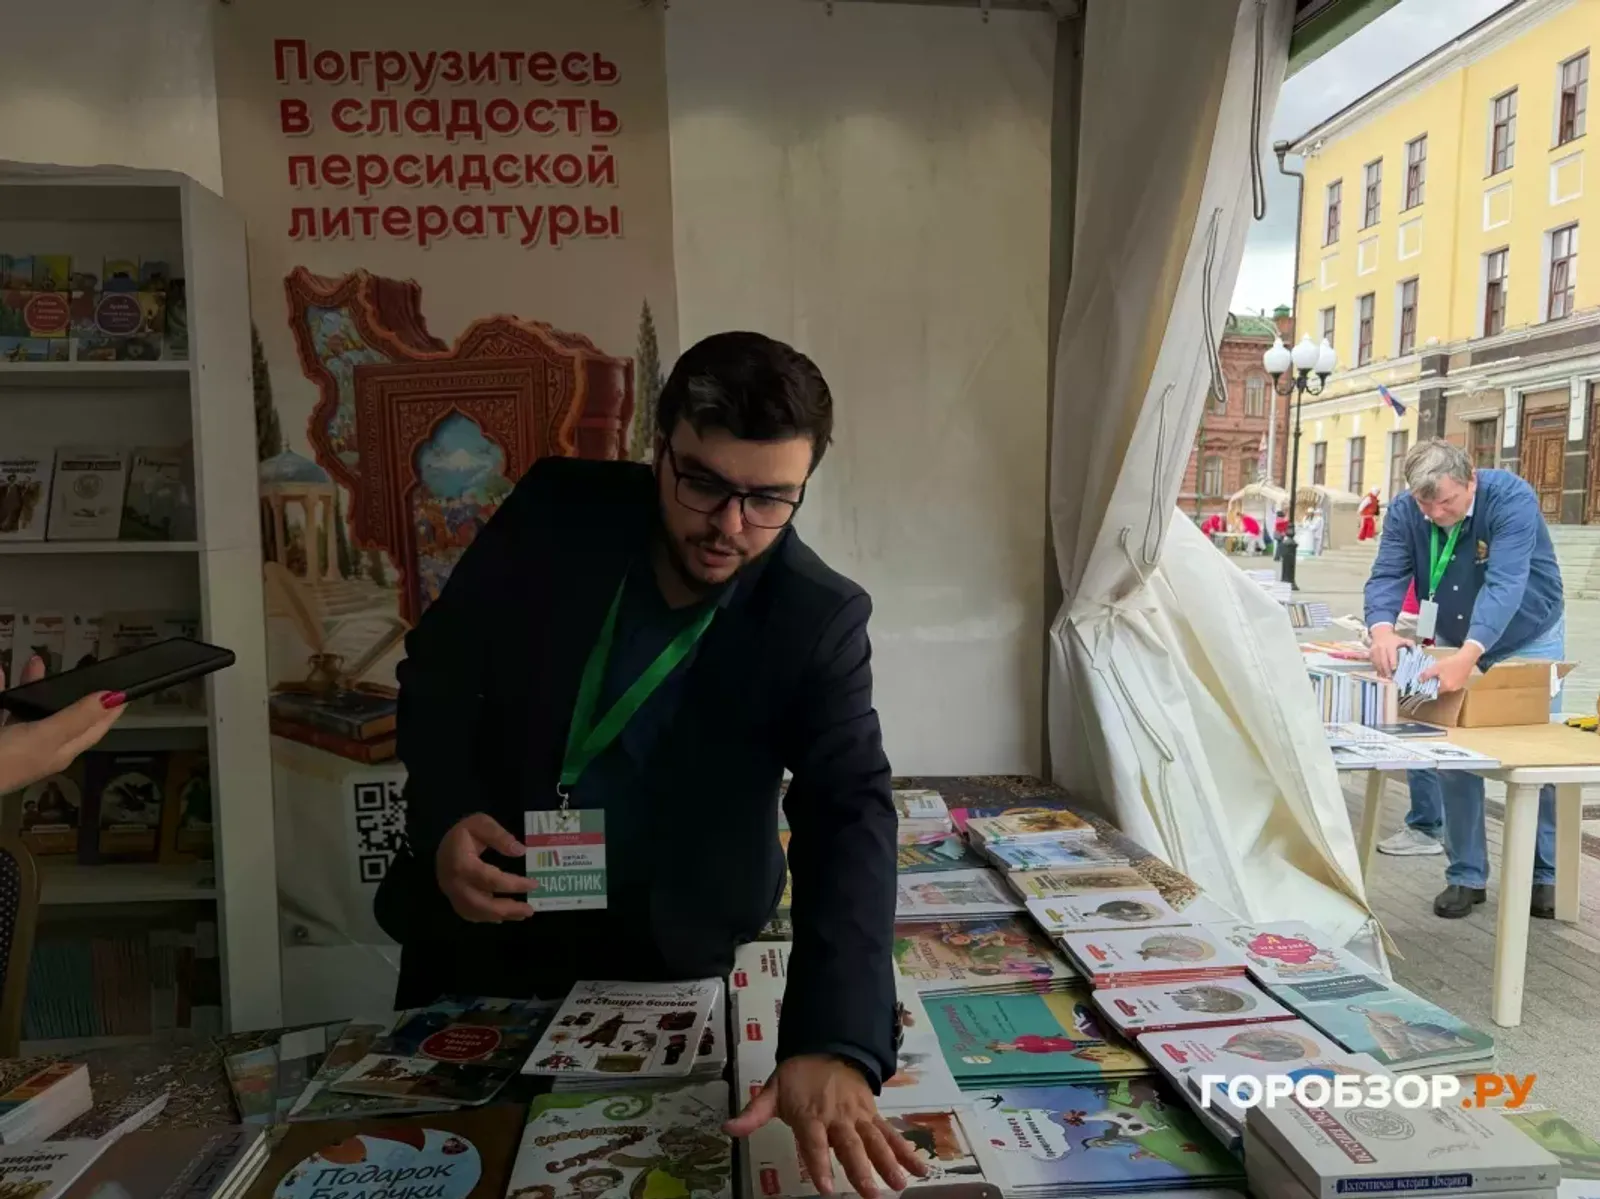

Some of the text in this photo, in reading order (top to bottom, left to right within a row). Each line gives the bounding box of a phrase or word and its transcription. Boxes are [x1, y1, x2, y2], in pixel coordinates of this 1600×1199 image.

[273, 38, 621, 94] Погрузитесь
[279, 97, 621, 141] в сладость
[287, 144, 617, 197] персидской
[287, 203, 621, 247] литературы
[531, 874, 602, 892] ЧАСТНИК
[646, 998, 698, 1008] больше
[0, 1153, 69, 1164] зидент
[312, 1163, 456, 1188] Подарок
